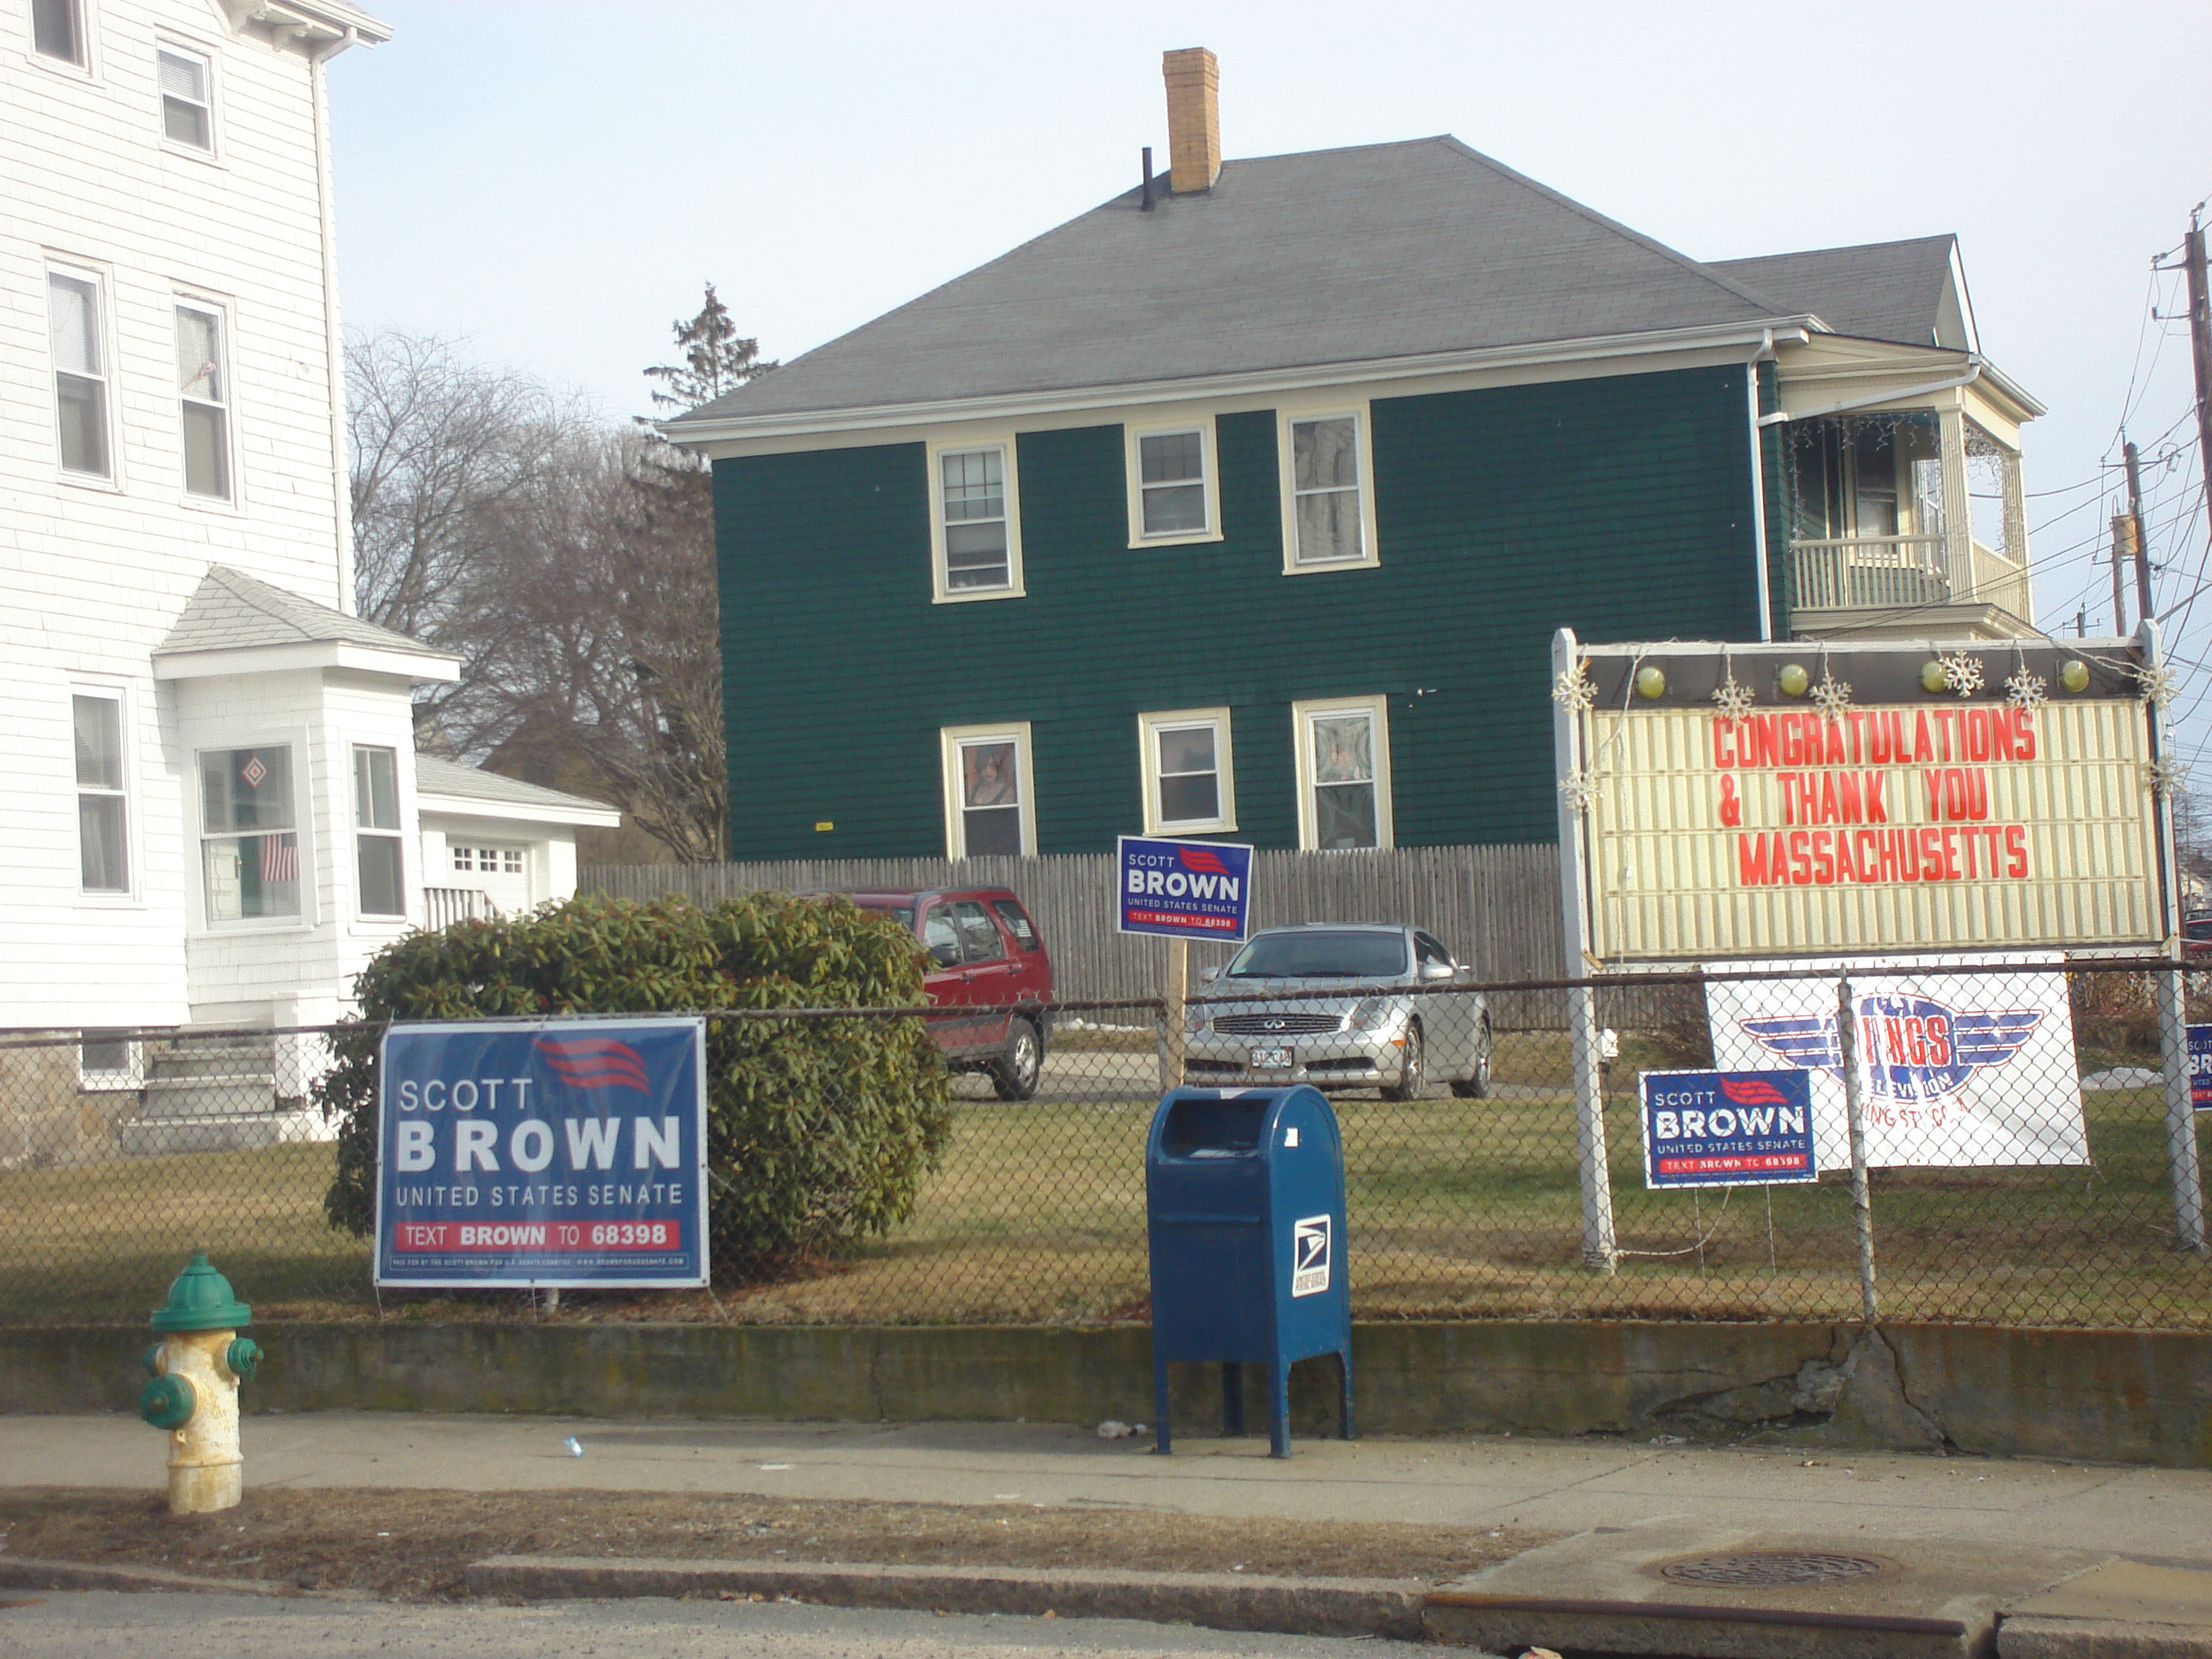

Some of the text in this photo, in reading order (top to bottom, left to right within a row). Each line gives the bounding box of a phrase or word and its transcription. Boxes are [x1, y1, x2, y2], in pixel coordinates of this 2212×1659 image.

[1713, 708, 2036, 768] CONGRATULATIONS
[1720, 767, 1988, 827] & THANK YOU
[1129, 854, 1175, 868] SCOTT
[1738, 824, 2029, 886] MASSACHUSETTS
[1128, 869, 1239, 901] BROWN
[1128, 897, 1238, 914] UNITED STATES SENATE
[1133, 912, 1152, 921] TEXT
[1155, 914, 1187, 924] BROWN
[1843, 1016, 1951, 1065] INGS
[400, 1078, 533, 1111] SCOTT
[1655, 1091, 1716, 1107] SCOTT
[1656, 1106, 1805, 1140] BROWN
[397, 1115, 680, 1172] BROWN
[1657, 1140, 1806, 1155] UNITED STATES SENATE
[1667, 1160, 1695, 1170] TEXT
[1699, 1159, 1741, 1169] BROWN
[397, 1183, 682, 1207] UNITED STATES SENATE
[405, 1224, 667, 1246] TEXT BROWN TO 68398
